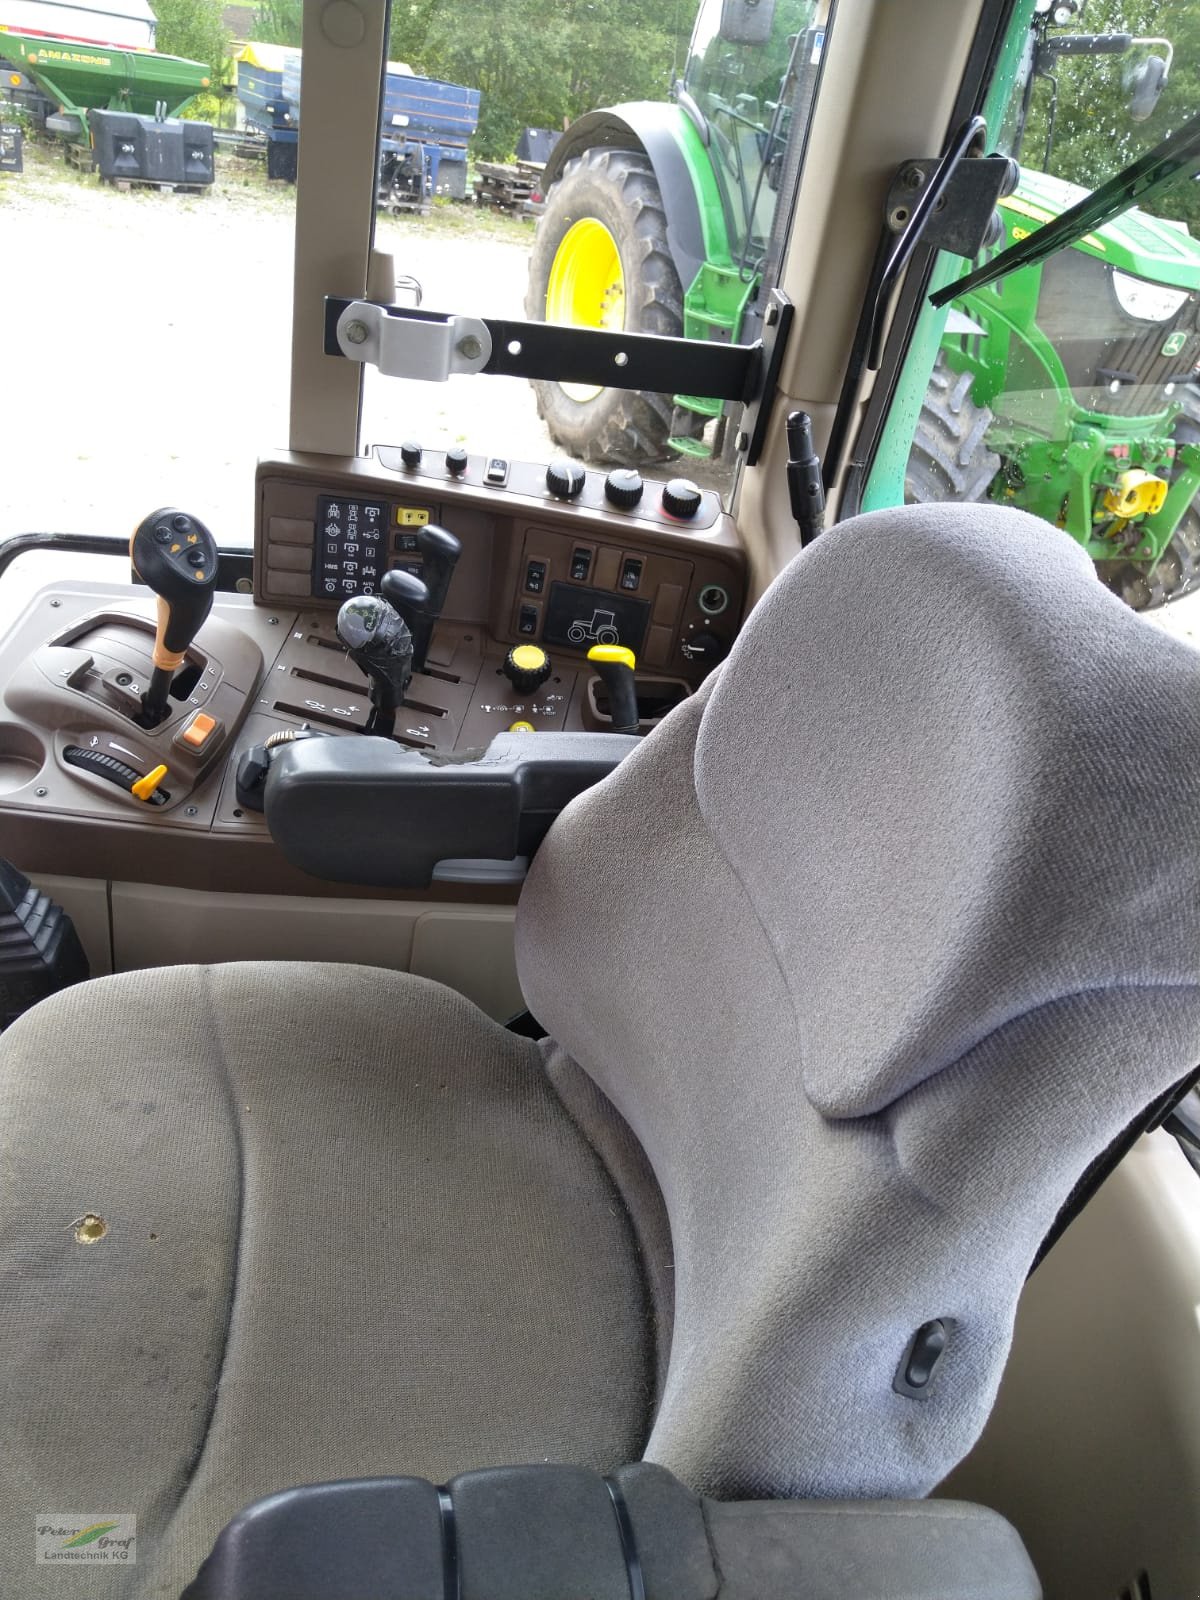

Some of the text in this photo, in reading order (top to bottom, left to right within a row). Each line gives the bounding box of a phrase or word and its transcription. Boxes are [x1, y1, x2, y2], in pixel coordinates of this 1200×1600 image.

[38, 48, 111, 65] AMAZONE
[208, 667, 216, 675] F
[129, 683, 140, 695] P
